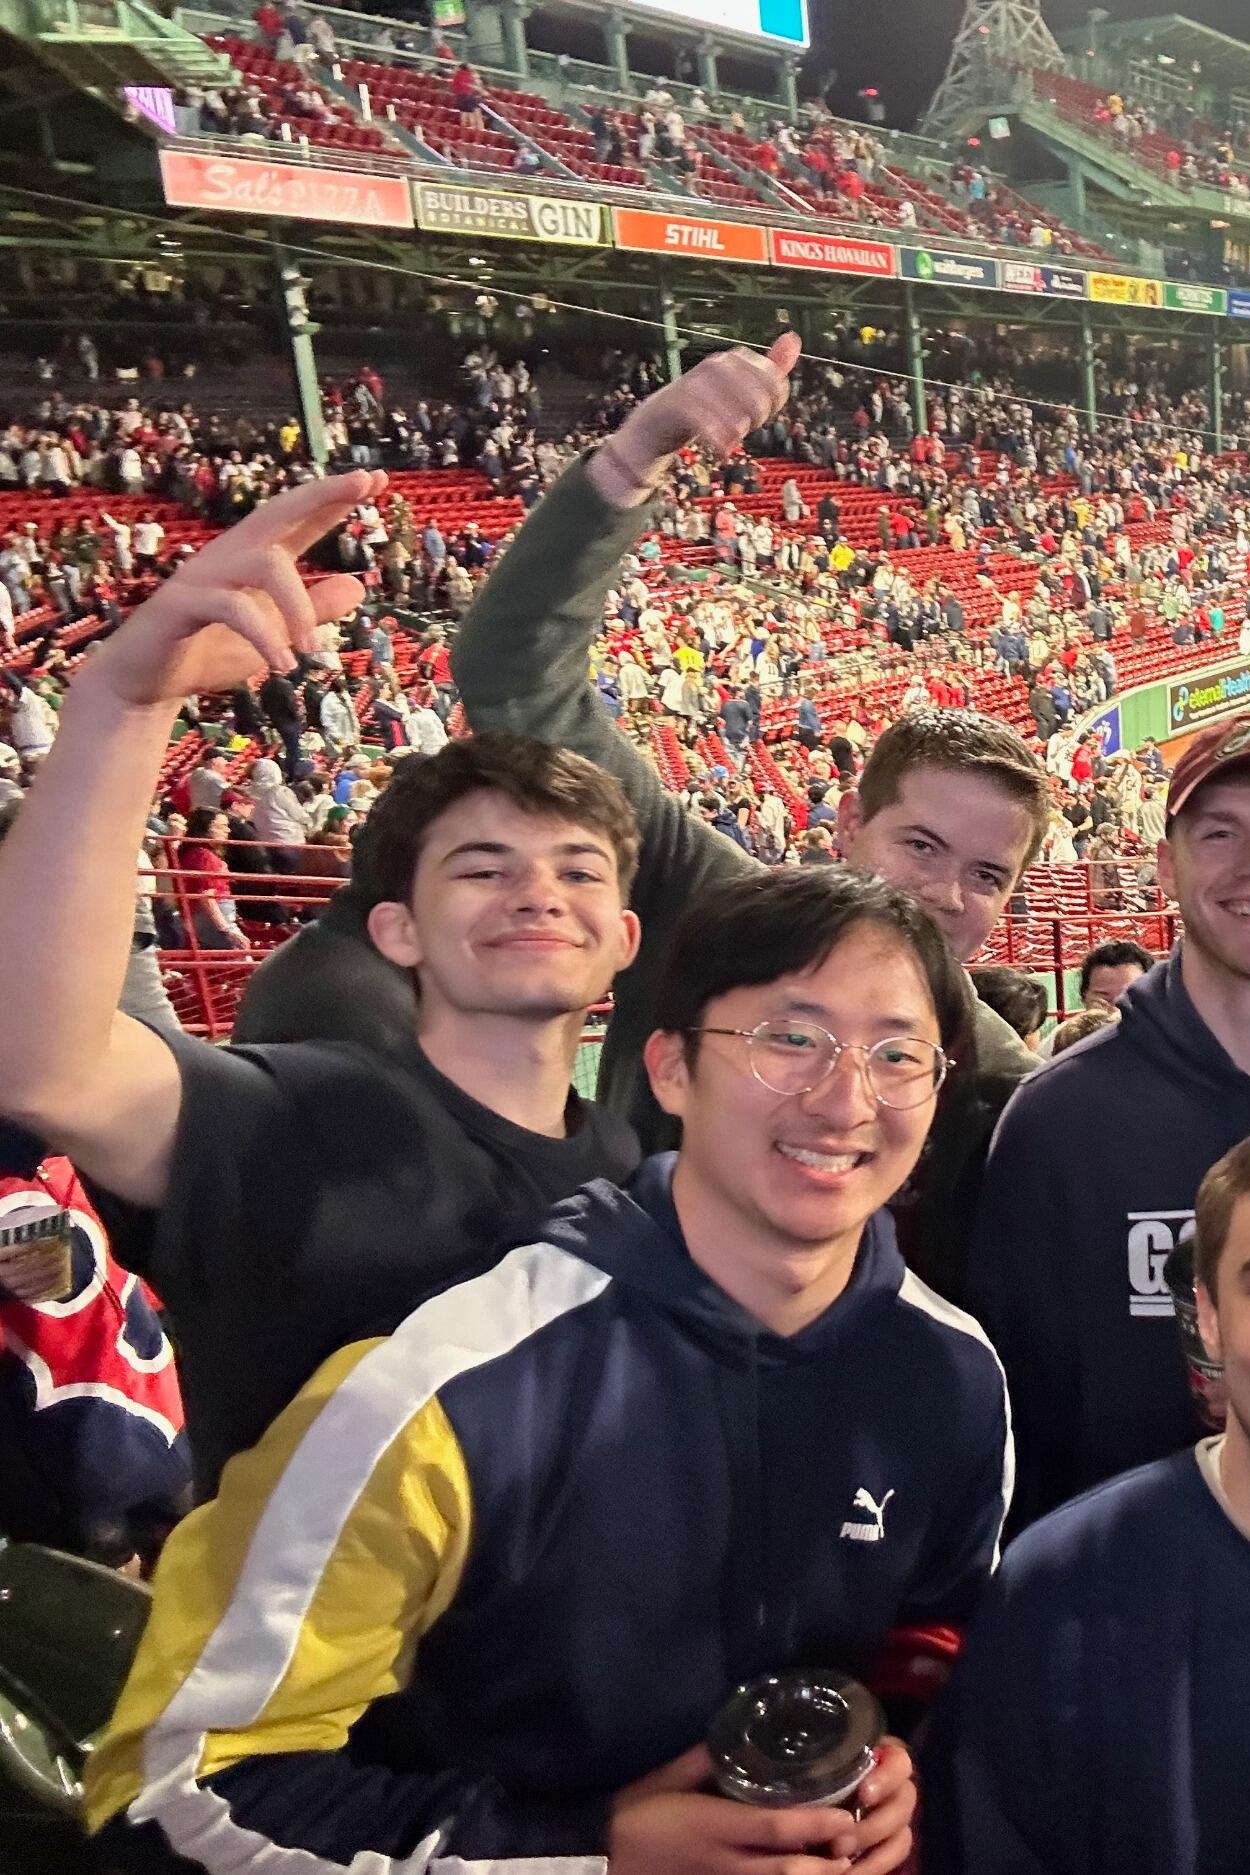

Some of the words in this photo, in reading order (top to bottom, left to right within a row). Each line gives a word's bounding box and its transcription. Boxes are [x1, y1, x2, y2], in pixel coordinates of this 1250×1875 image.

[203, 164, 282, 208] Sal's
[422, 190, 528, 219] BUILDERS
[538, 203, 594, 240] GIN
[664, 223, 725, 251] STIHL
[779, 238, 824, 261] KING'S
[824, 243, 889, 270] HAWAIIAN
